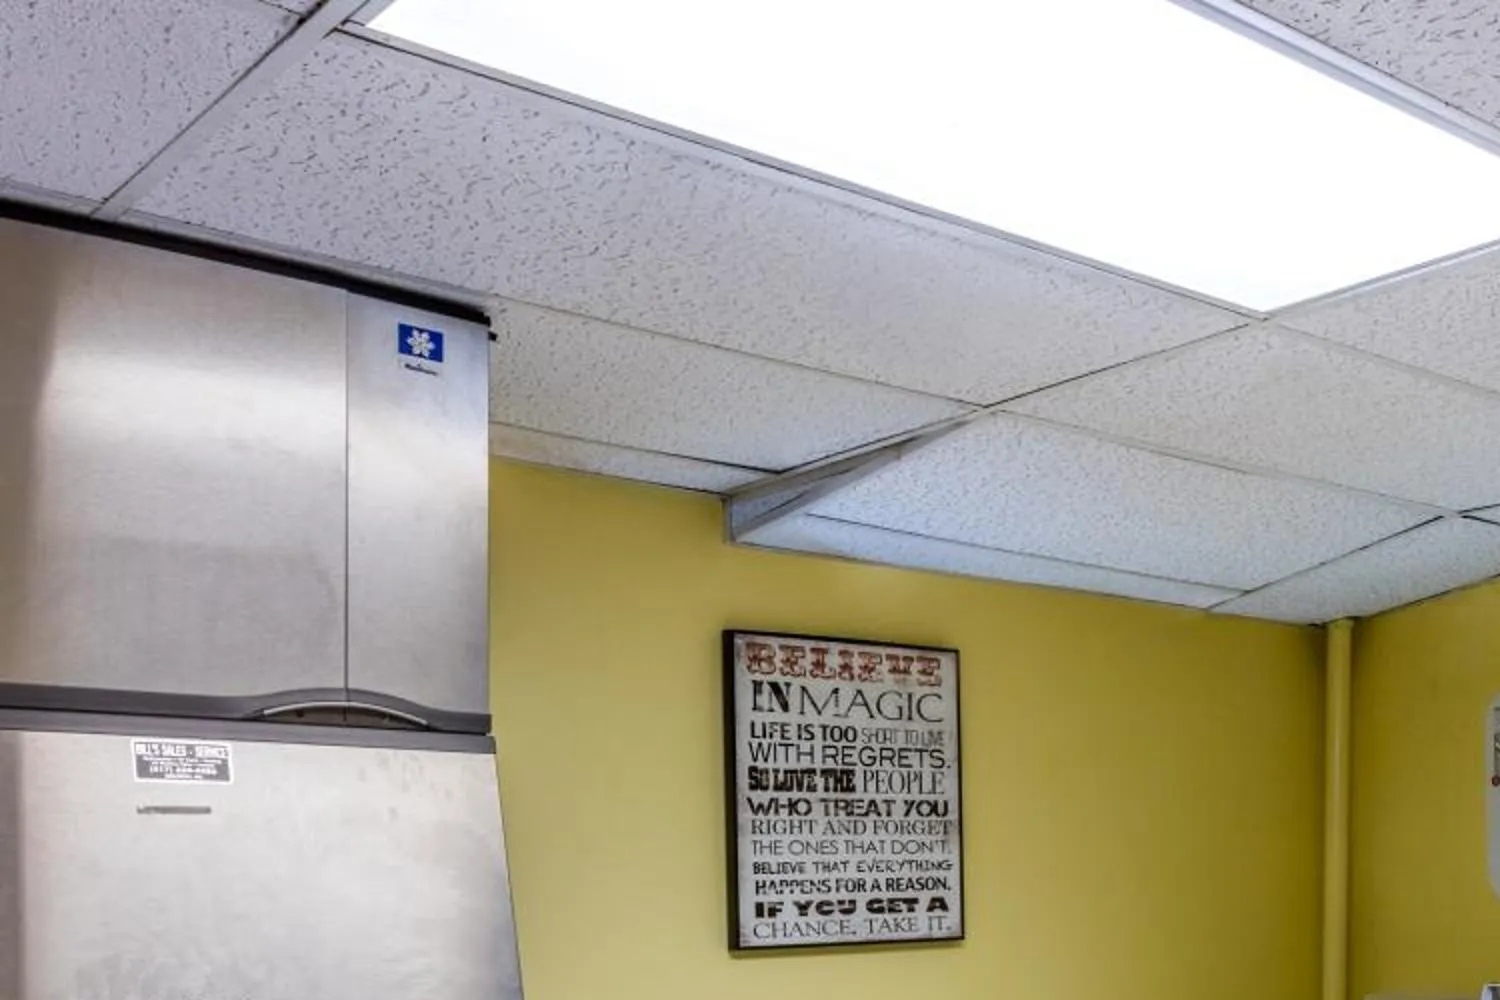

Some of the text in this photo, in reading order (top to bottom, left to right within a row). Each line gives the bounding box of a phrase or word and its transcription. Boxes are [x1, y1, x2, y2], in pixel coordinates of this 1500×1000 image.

[745, 641, 943, 687] BELIEVE
[751, 679, 945, 723] IN MAGIC
[750, 720, 946, 748] LIFE IS TOO SHORT TO LIVE
[748, 742, 952, 769] WITH REGRETS.
[748, 766, 946, 795] SO LOVE THE PEOPLE
[746, 797, 950, 818] WHO TREAT YOU
[751, 819, 953, 836] RIGHT AND FORGET
[751, 839, 783, 856] THE
[787, 839, 839, 855] ONES
[843, 839, 887, 855] THAT
[753, 857, 953, 875] BELIEVE THAT EVERYTHING
[755, 876, 951, 896] HAPPENS FOR A REASON.
[754, 896, 949, 919] IF YOU GET A
[864, 917, 919, 935] TAKE
[927, 916, 951, 932] IT.
